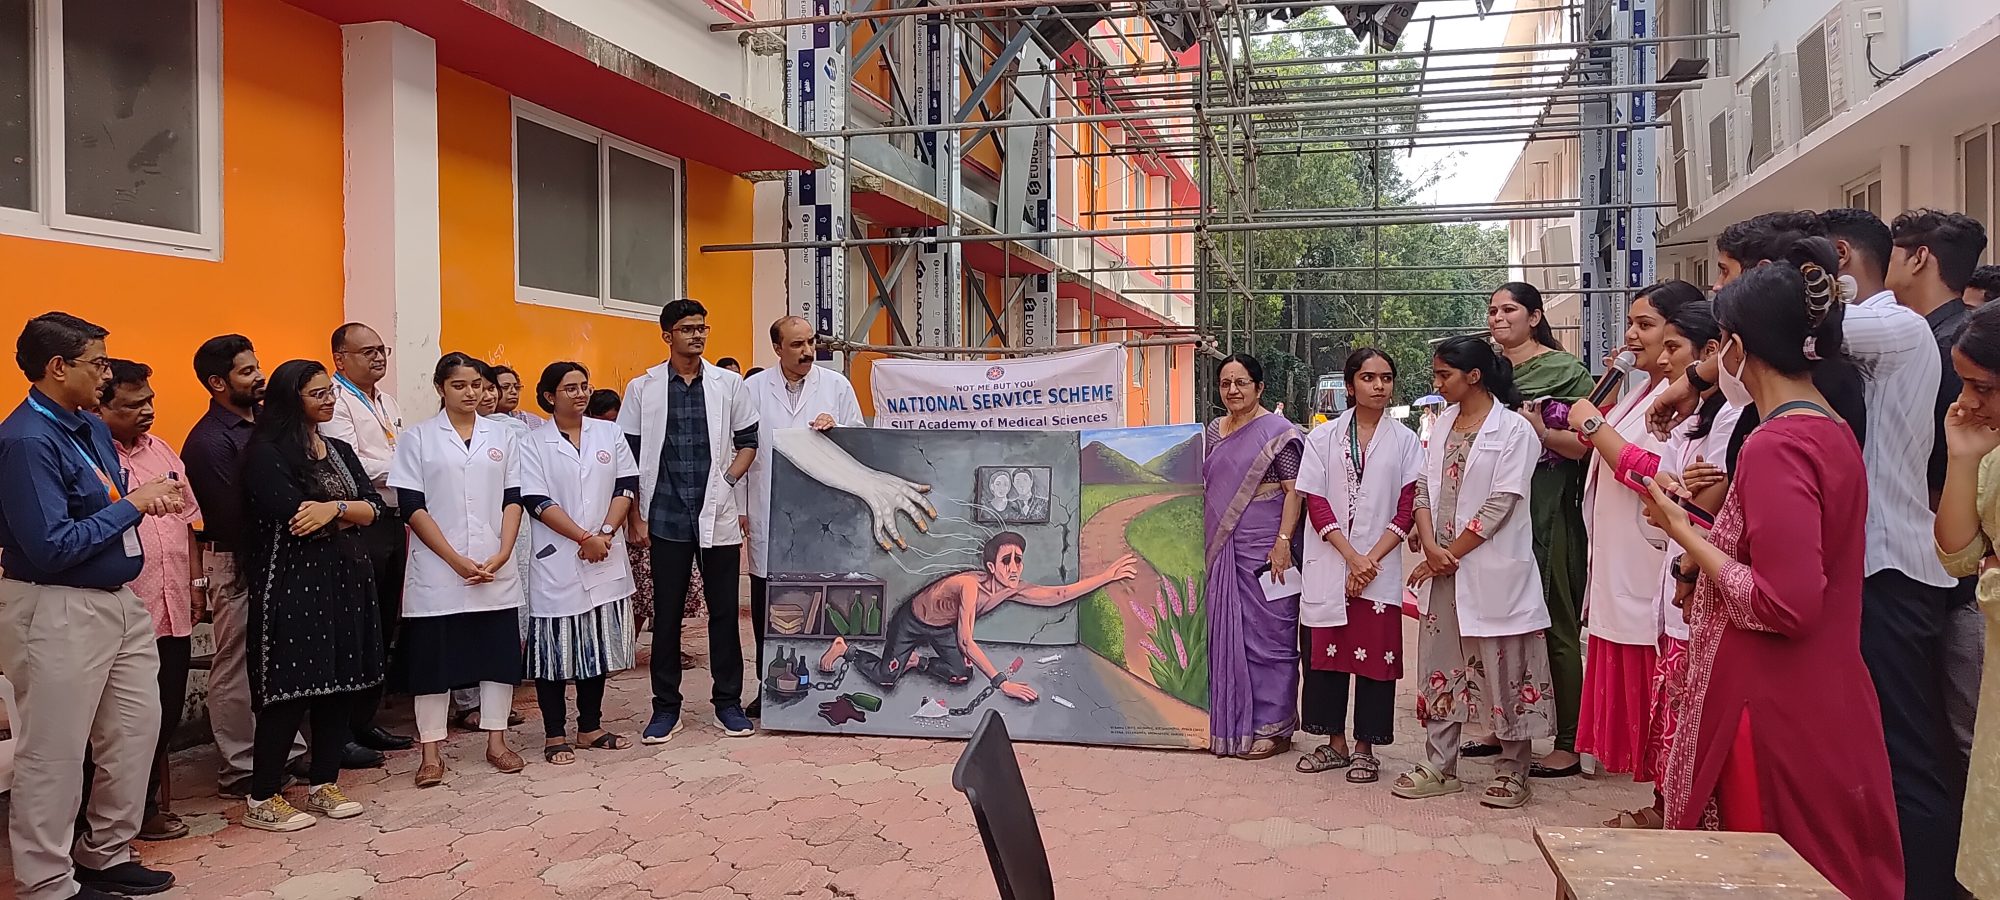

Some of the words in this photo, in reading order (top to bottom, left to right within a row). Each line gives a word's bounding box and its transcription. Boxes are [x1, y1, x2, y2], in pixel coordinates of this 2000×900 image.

[1025, 314, 1034, 346] EURO
[993, 382, 1011, 390] BUT
[887, 395, 968, 414] NATIONAL
[972, 389, 1043, 410] SERVICE
[1048, 384, 1114, 404] SCHEME
[918, 418, 977, 429] Academy
[980, 417, 994, 428] of
[997, 416, 1047, 428] Medical
[1052, 412, 1108, 426] Sciences
